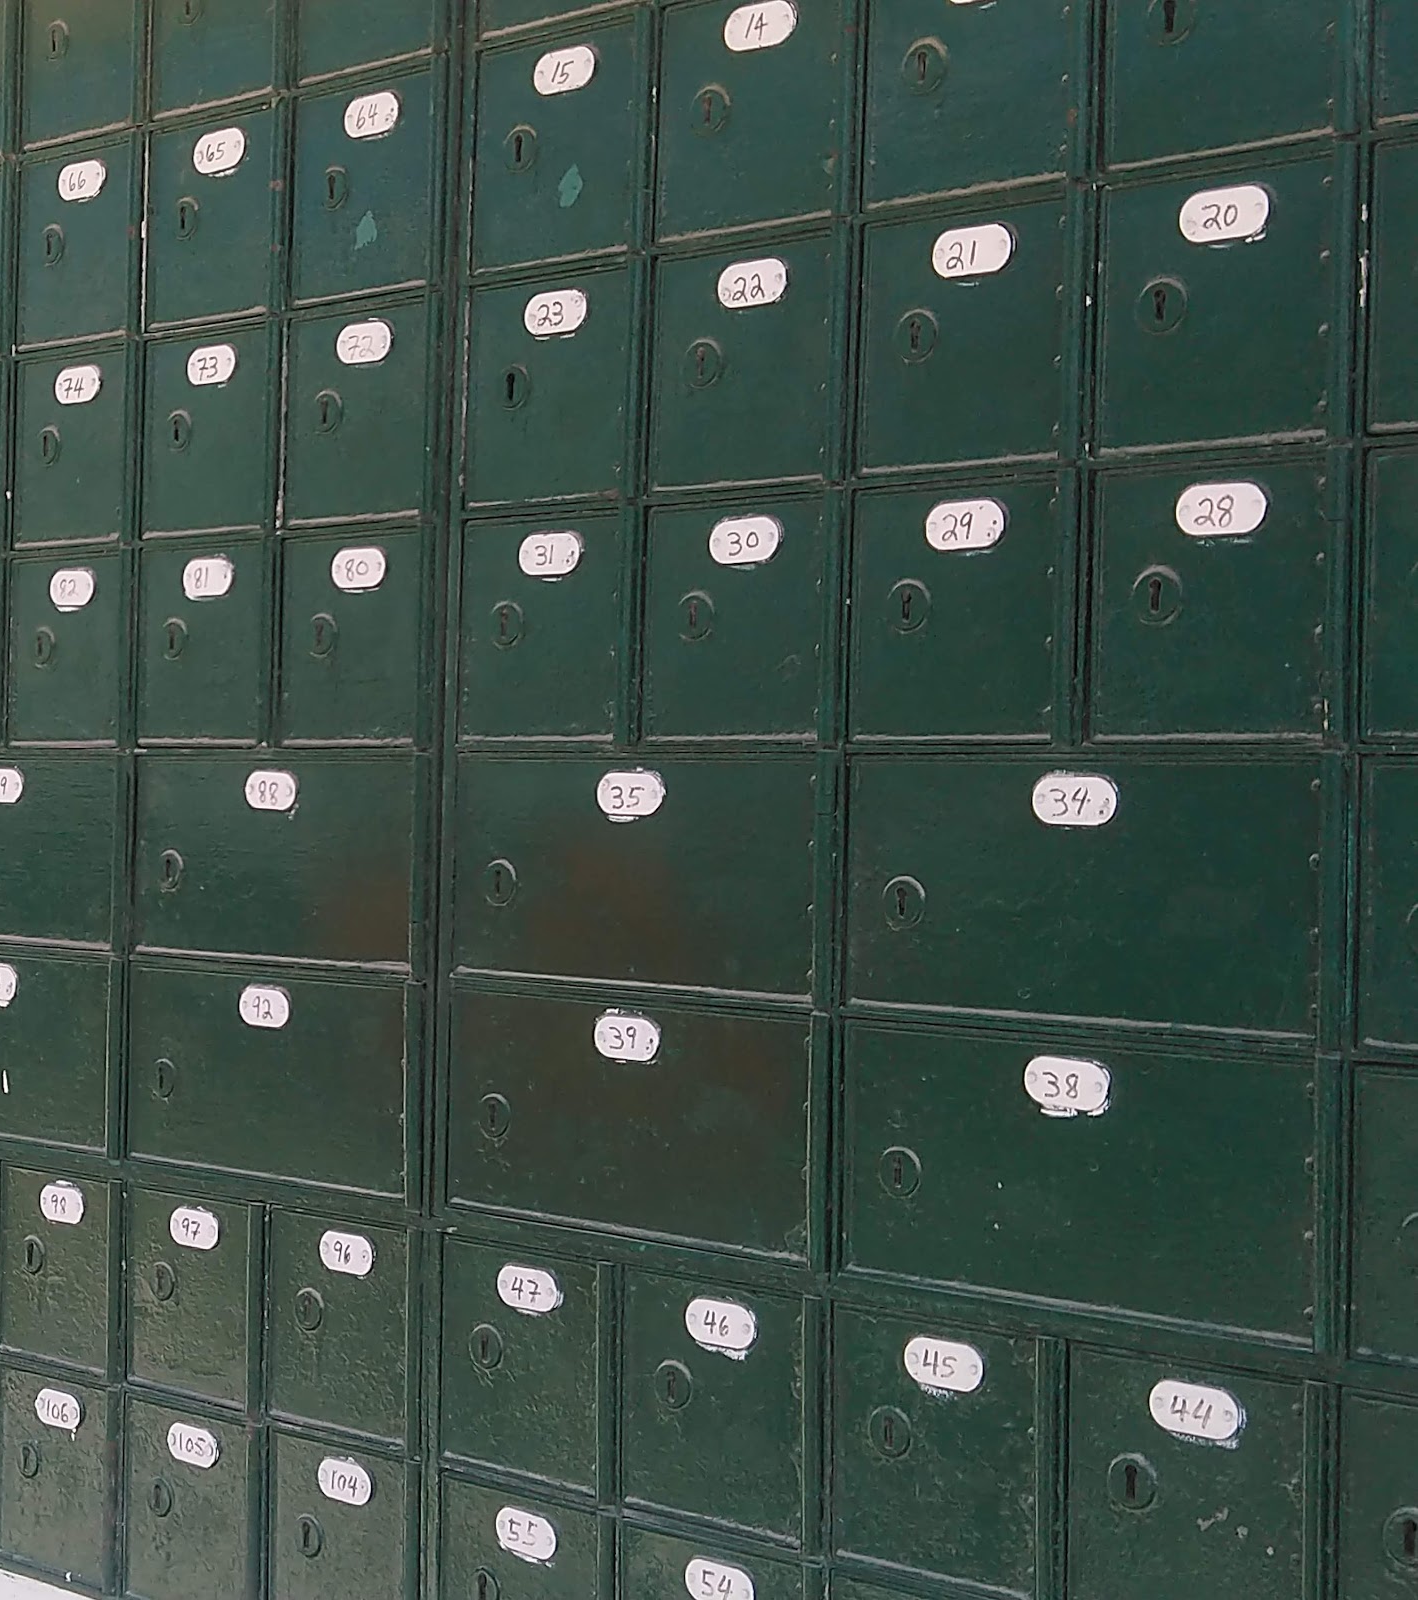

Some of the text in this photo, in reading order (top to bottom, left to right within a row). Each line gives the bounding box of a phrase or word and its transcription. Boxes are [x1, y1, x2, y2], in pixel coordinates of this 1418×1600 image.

[744, 12, 768, 41] 14
[551, 60, 575, 85] 15
[355, 103, 379, 131] 64
[205, 141, 226, 163] 65
[68, 170, 87, 192] 66
[1201, 203, 1238, 231] 20
[945, 239, 977, 271] 21
[731, 273, 766, 302] 22
[536, 301, 564, 327] 23
[347, 334, 371, 359] 72
[196, 356, 218, 380] 73
[62, 377, 85, 399] 74
[1193, 494, 1235, 528] 28
[941, 511, 974, 542] 29
[534, 544, 554, 566] 31
[727, 531, 760, 557] 30
[193, 566, 209, 590] 81
[344, 558, 369, 582] 80
[59, 578, 76, 600] 82
[258, 780, 279, 806] 88
[610, 785, 645, 810] 35
[1049, 787, 1089, 817] 34
[252, 995, 274, 1020] 92
[608, 1025, 637, 1050] 39
[1042, 1071, 1079, 1100] 38
[50, 1193, 67, 1215] 98
[181, 1217, 201, 1241] 97
[333, 1240, 351, 1265] 96
[510, 1276, 542, 1301] 47
[703, 1309, 729, 1337] 46
[922, 1348, 957, 1377] 45
[46, 1398, 69, 1424] 106
[1170, 1395, 1213, 1424] 44
[179, 1432, 206, 1457] 105
[331, 1469, 358, 1498] 104
[506, 1517, 538, 1547] 55
[701, 1569, 732, 1597] 54
